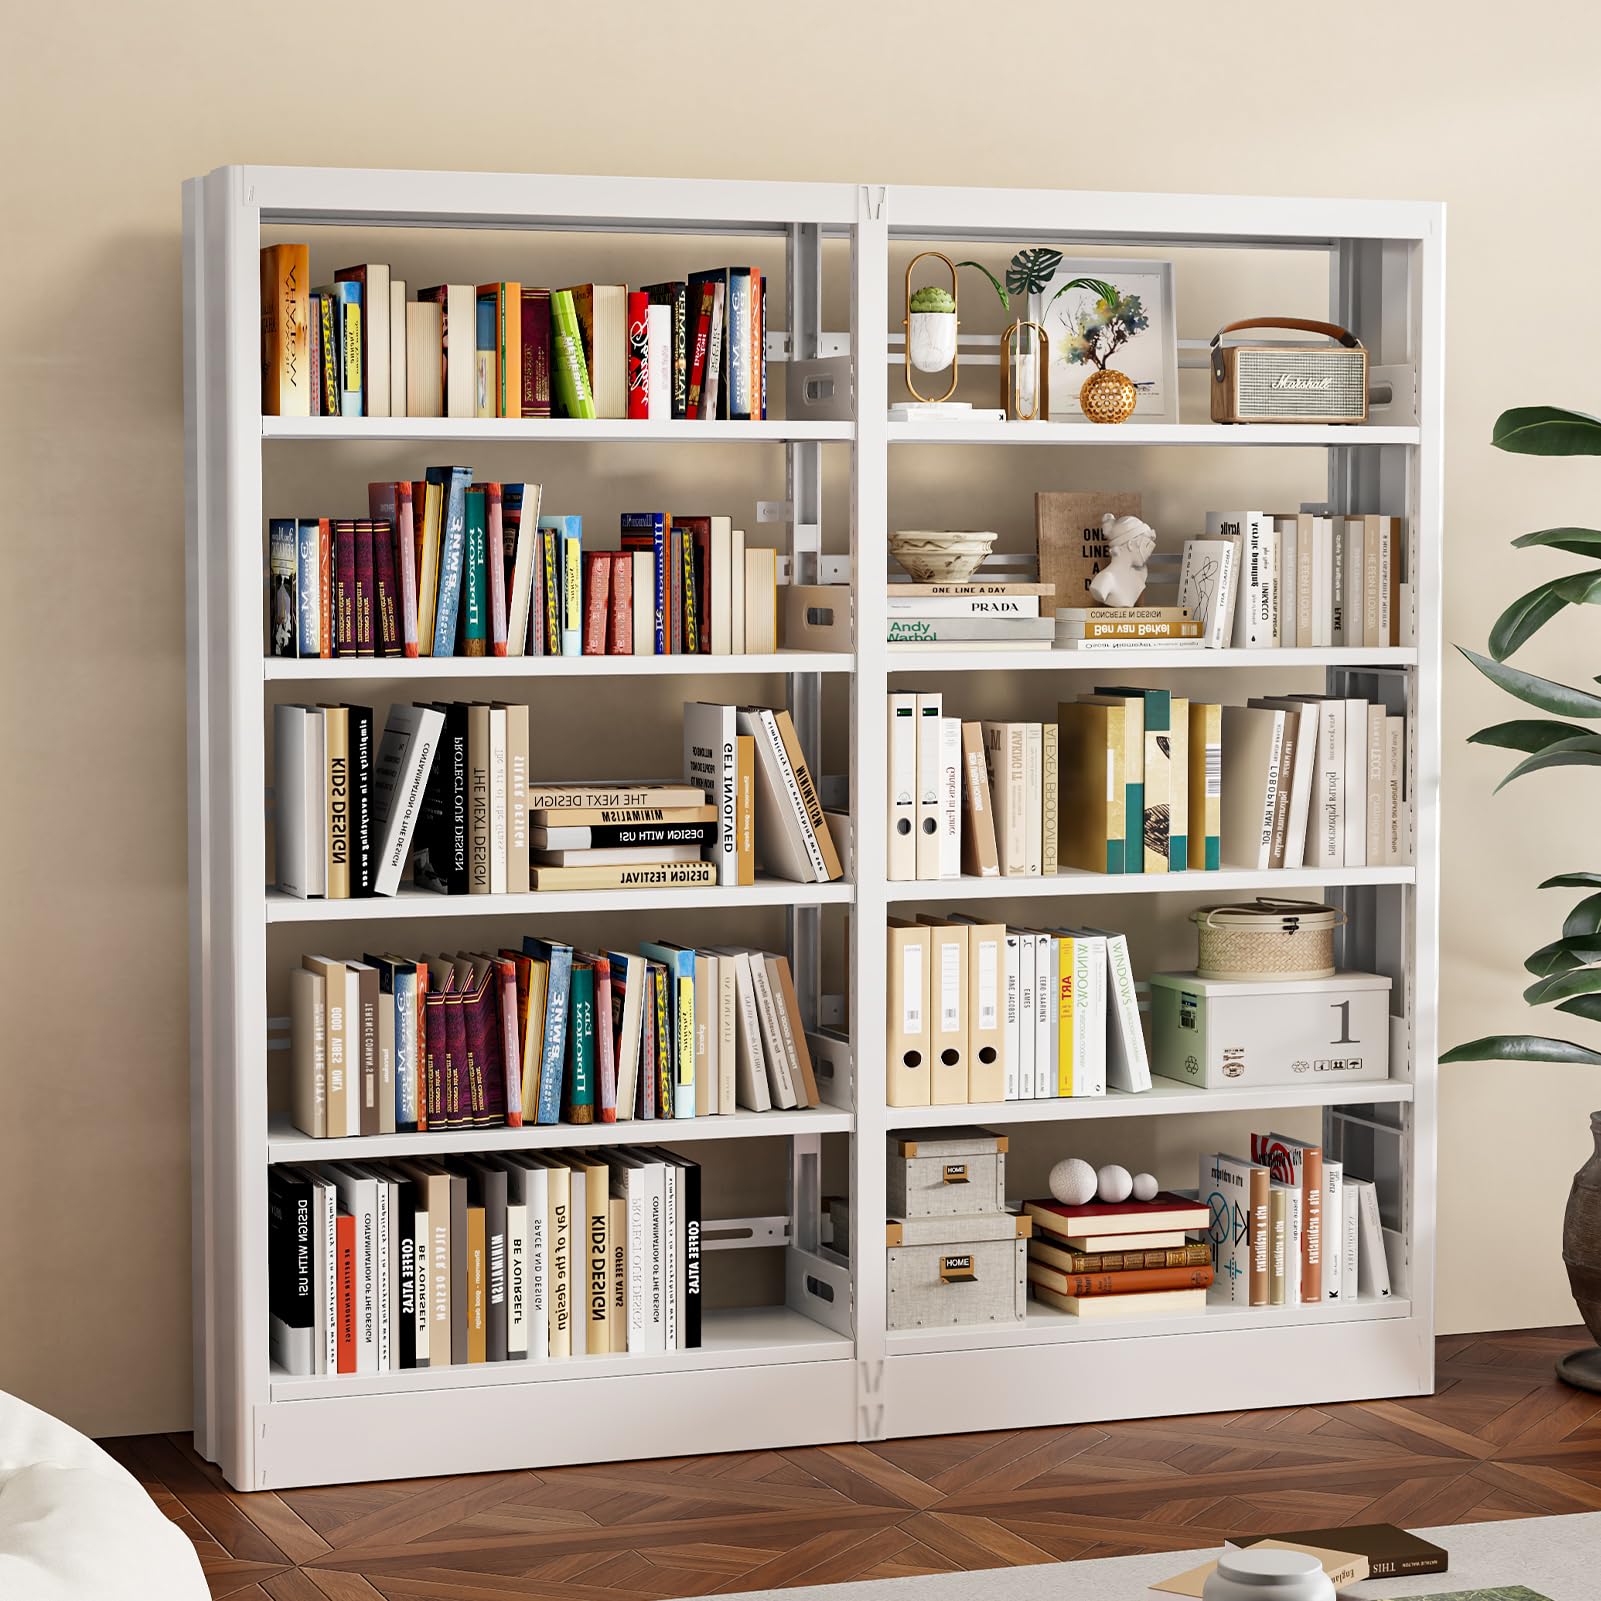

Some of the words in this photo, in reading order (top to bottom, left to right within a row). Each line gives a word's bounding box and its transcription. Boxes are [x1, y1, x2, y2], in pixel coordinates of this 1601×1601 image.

[1272, 374, 1332, 390] Marshall
[1082, 546, 1110, 558] LINE
[1092, 564, 1100, 575] A
[972, 602, 1018, 612] PRADA
[890, 622, 930, 634] Andy
[1112, 942, 1132, 1005] WINDOWS
[1330, 1000, 1360, 1044] 1
[947, 1258, 970, 1268] HOME
[1329, 1290, 1338, 1298] K
[1373, 1562, 1396, 1573] THIS
